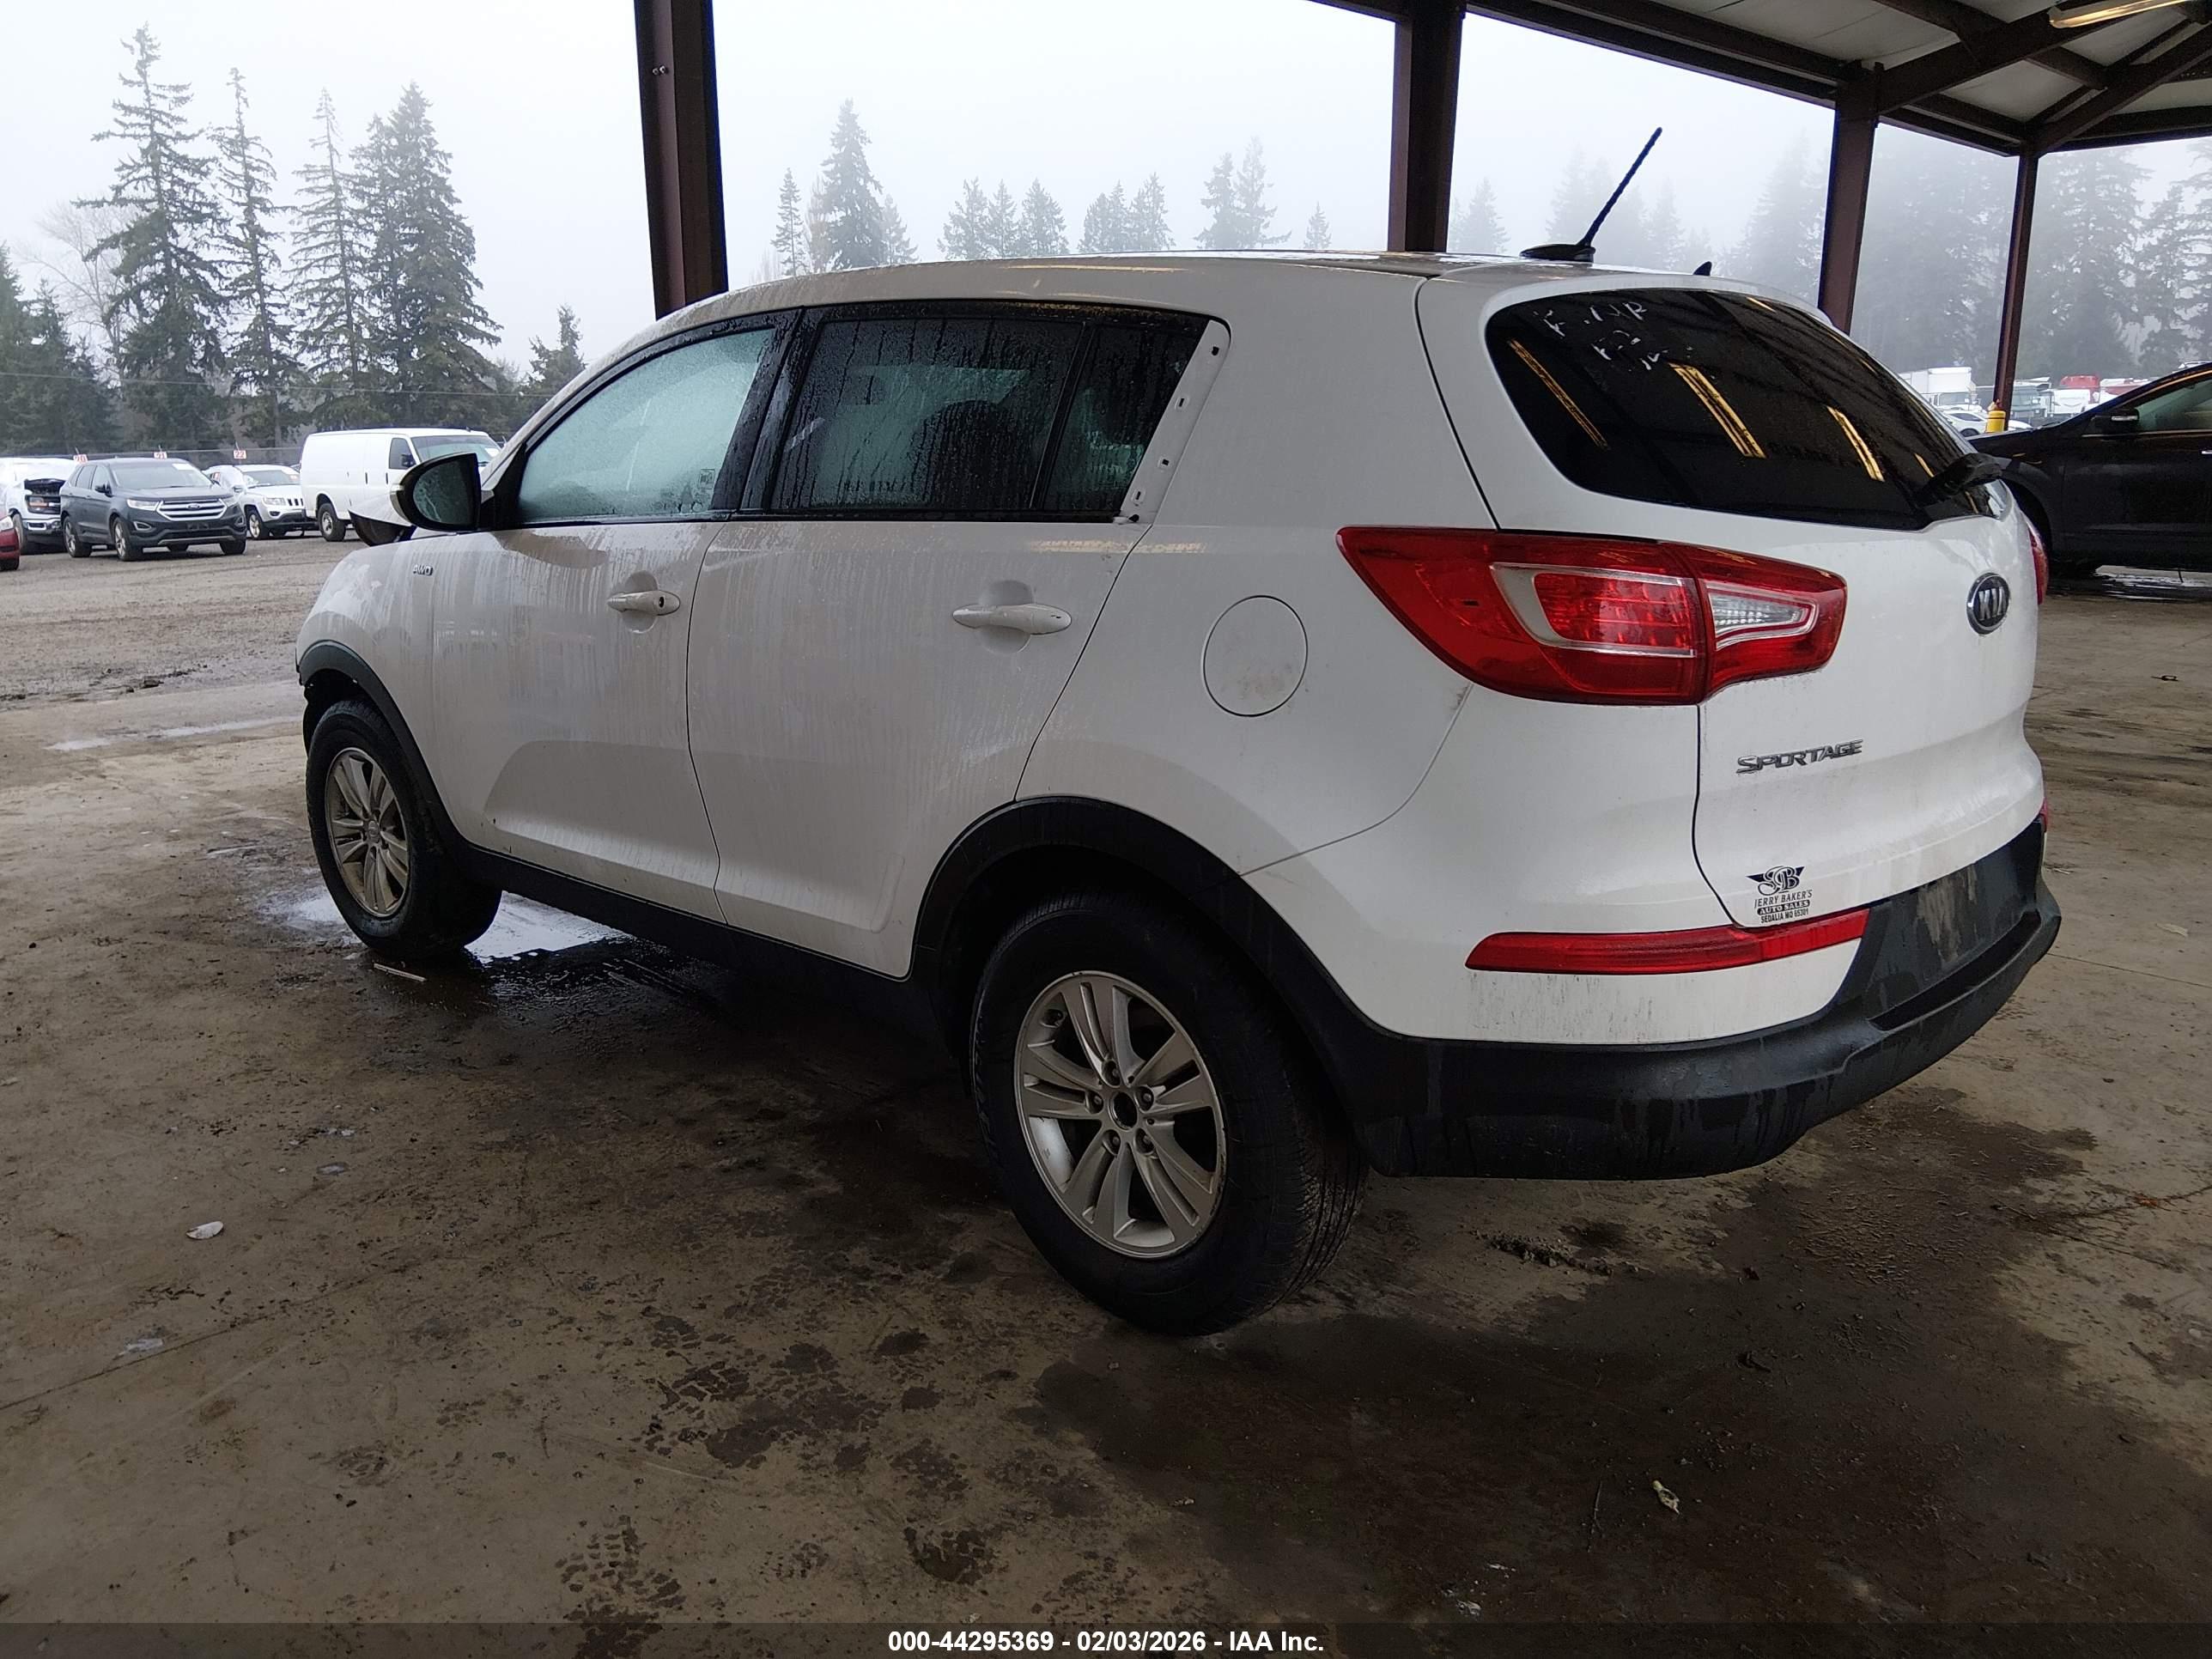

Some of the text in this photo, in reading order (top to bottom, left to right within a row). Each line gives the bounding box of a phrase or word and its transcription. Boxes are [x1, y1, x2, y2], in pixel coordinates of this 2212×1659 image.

[412, 564, 434, 576] AWD
[1735, 738, 1863, 774] SPORTAGE
[1754, 889, 1813, 908] JERRY BAKER'S
[1760, 900, 1808, 915] AUTO SALES
[1760, 912, 1784, 923] SEDALIA
[1785, 910, 1794, 919] MO
